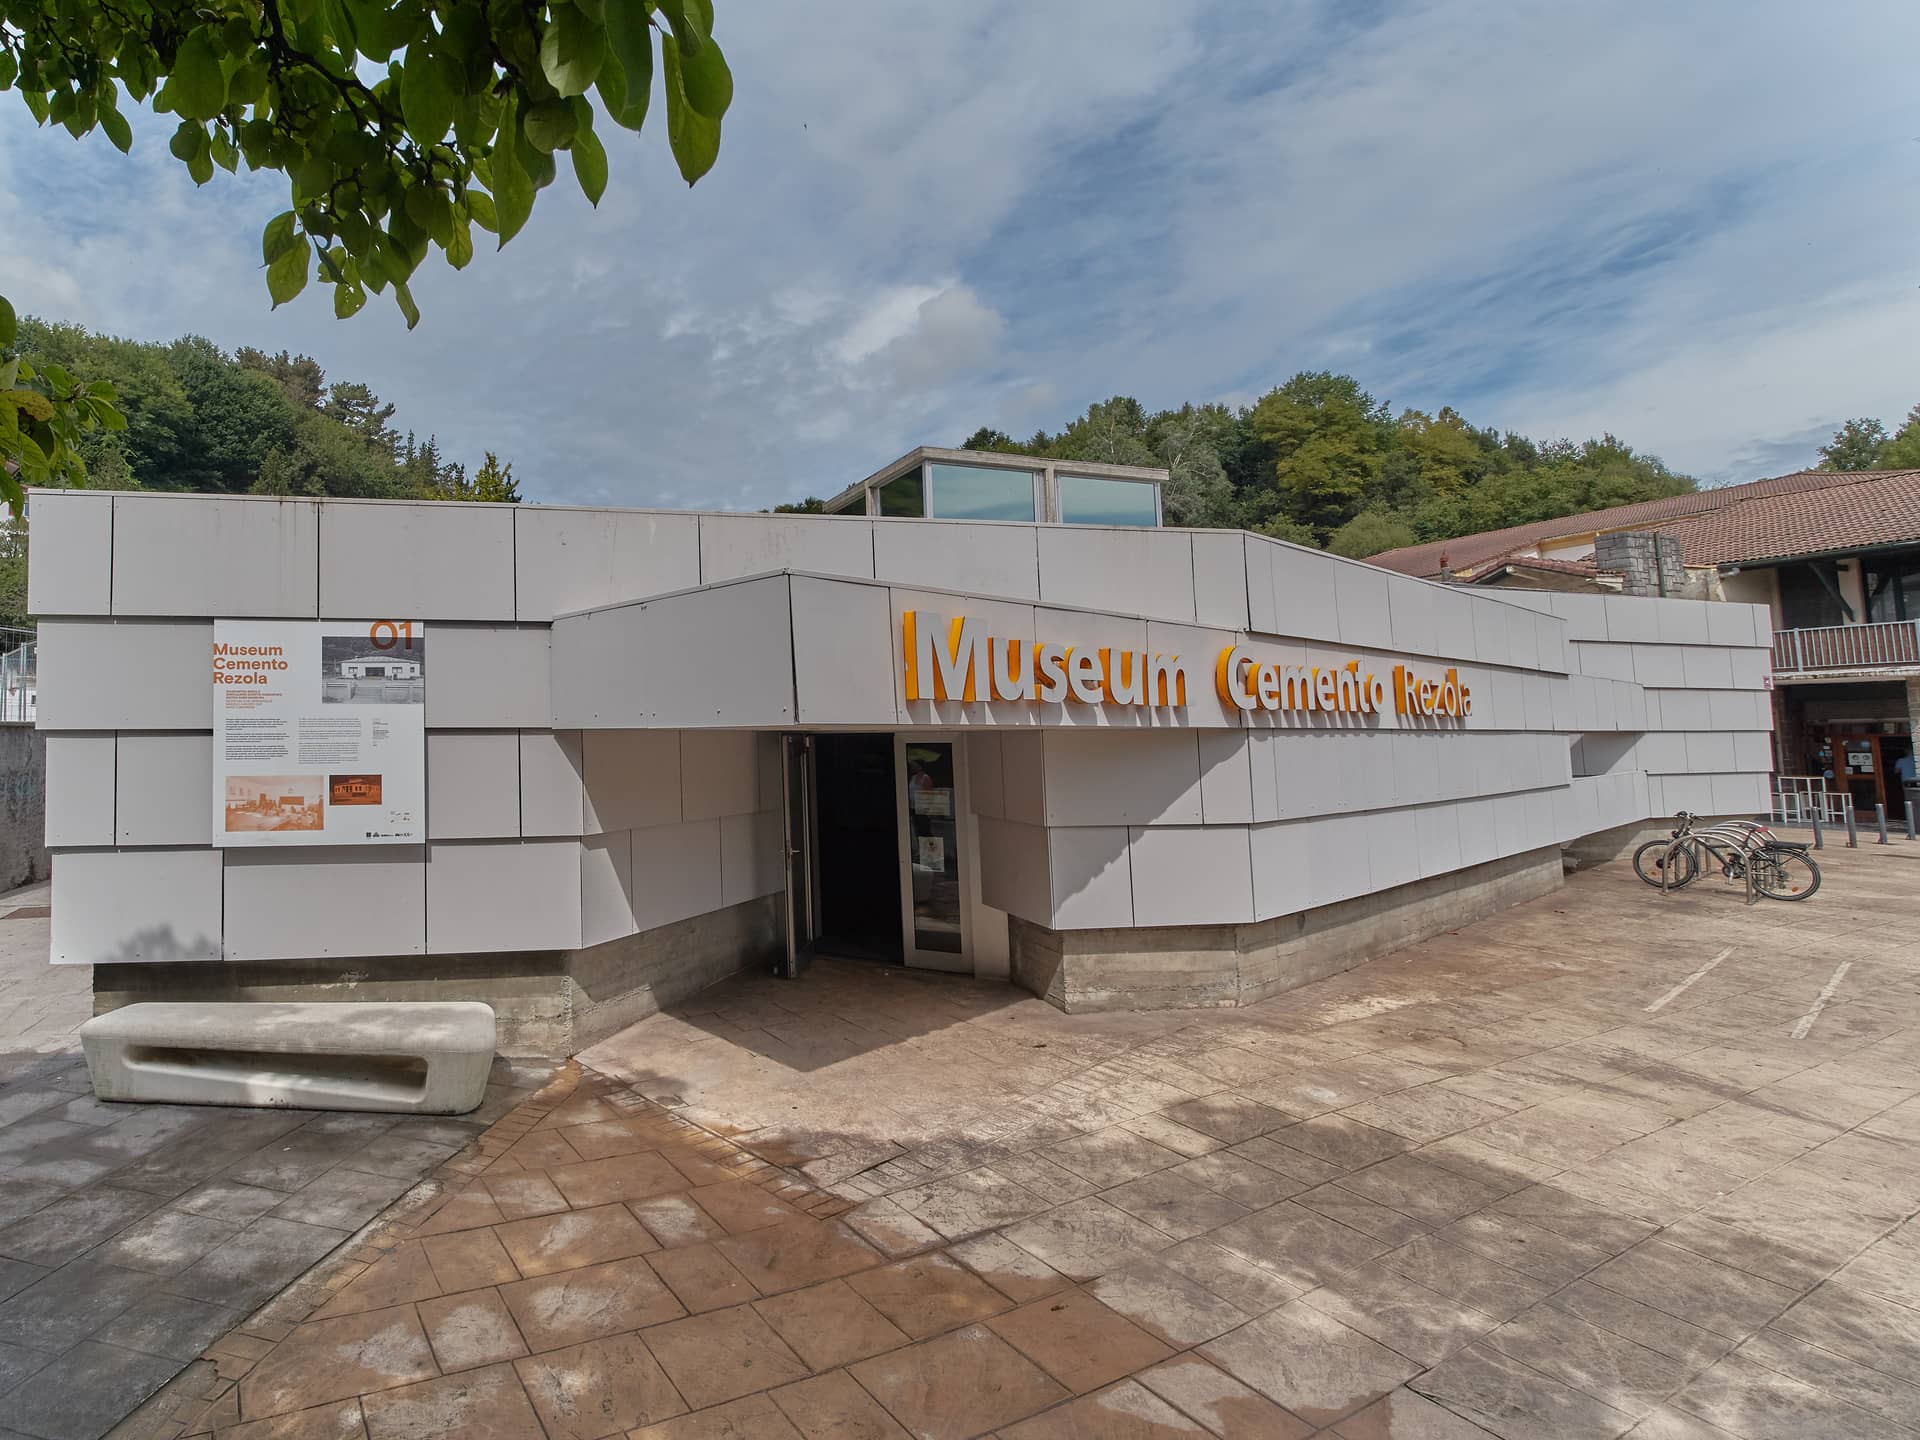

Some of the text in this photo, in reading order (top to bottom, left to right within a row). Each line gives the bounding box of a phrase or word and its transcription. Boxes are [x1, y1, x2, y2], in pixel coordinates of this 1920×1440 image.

[369, 620, 412, 650] 01
[213, 643, 283, 656] Museum
[213, 657, 288, 671] Cemento
[903, 609, 1472, 718] Museum Cemento Rezola
[213, 671, 268, 685] Rezola
